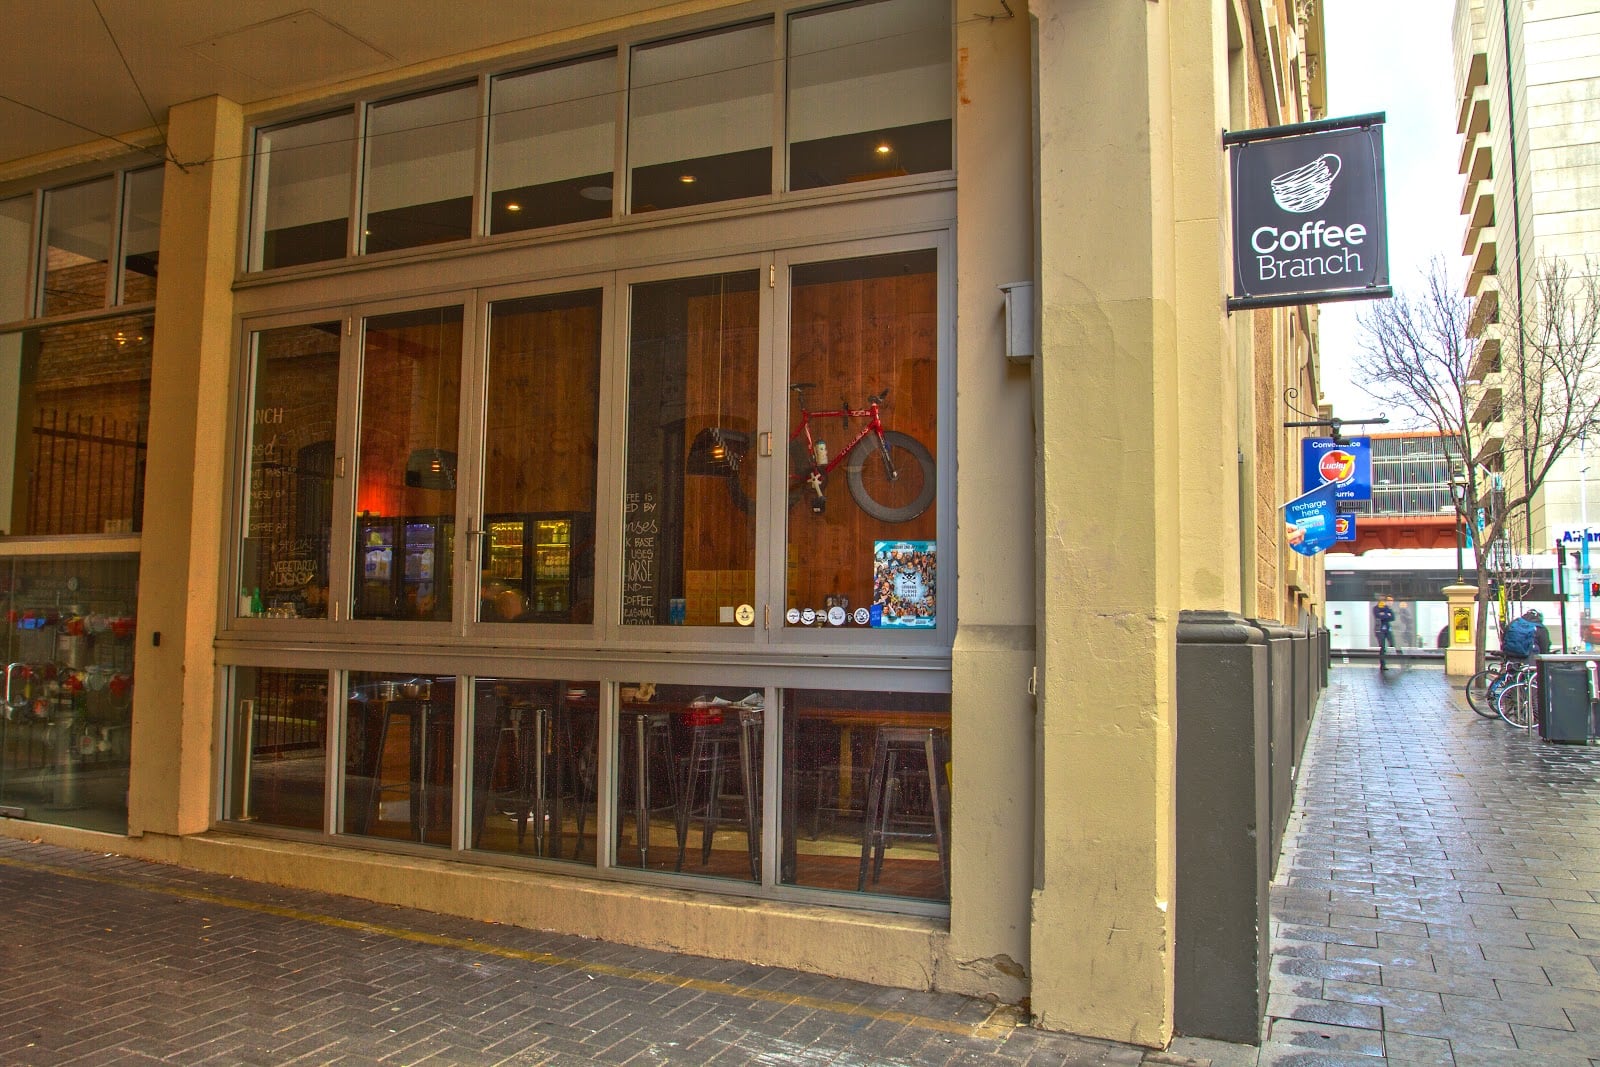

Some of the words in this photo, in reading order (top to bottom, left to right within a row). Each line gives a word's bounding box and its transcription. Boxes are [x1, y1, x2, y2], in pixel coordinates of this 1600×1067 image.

[1251, 220, 1367, 254] Coffee
[1256, 247, 1364, 280] Branch
[1321, 461, 1347, 472] Lucky
[1339, 455, 1356, 478] 7
[643, 503, 656, 512] BY
[1292, 500, 1327, 512] recharge
[1301, 508, 1319, 518] here
[634, 537, 655, 548] BASE
[631, 549, 654, 560] USES
